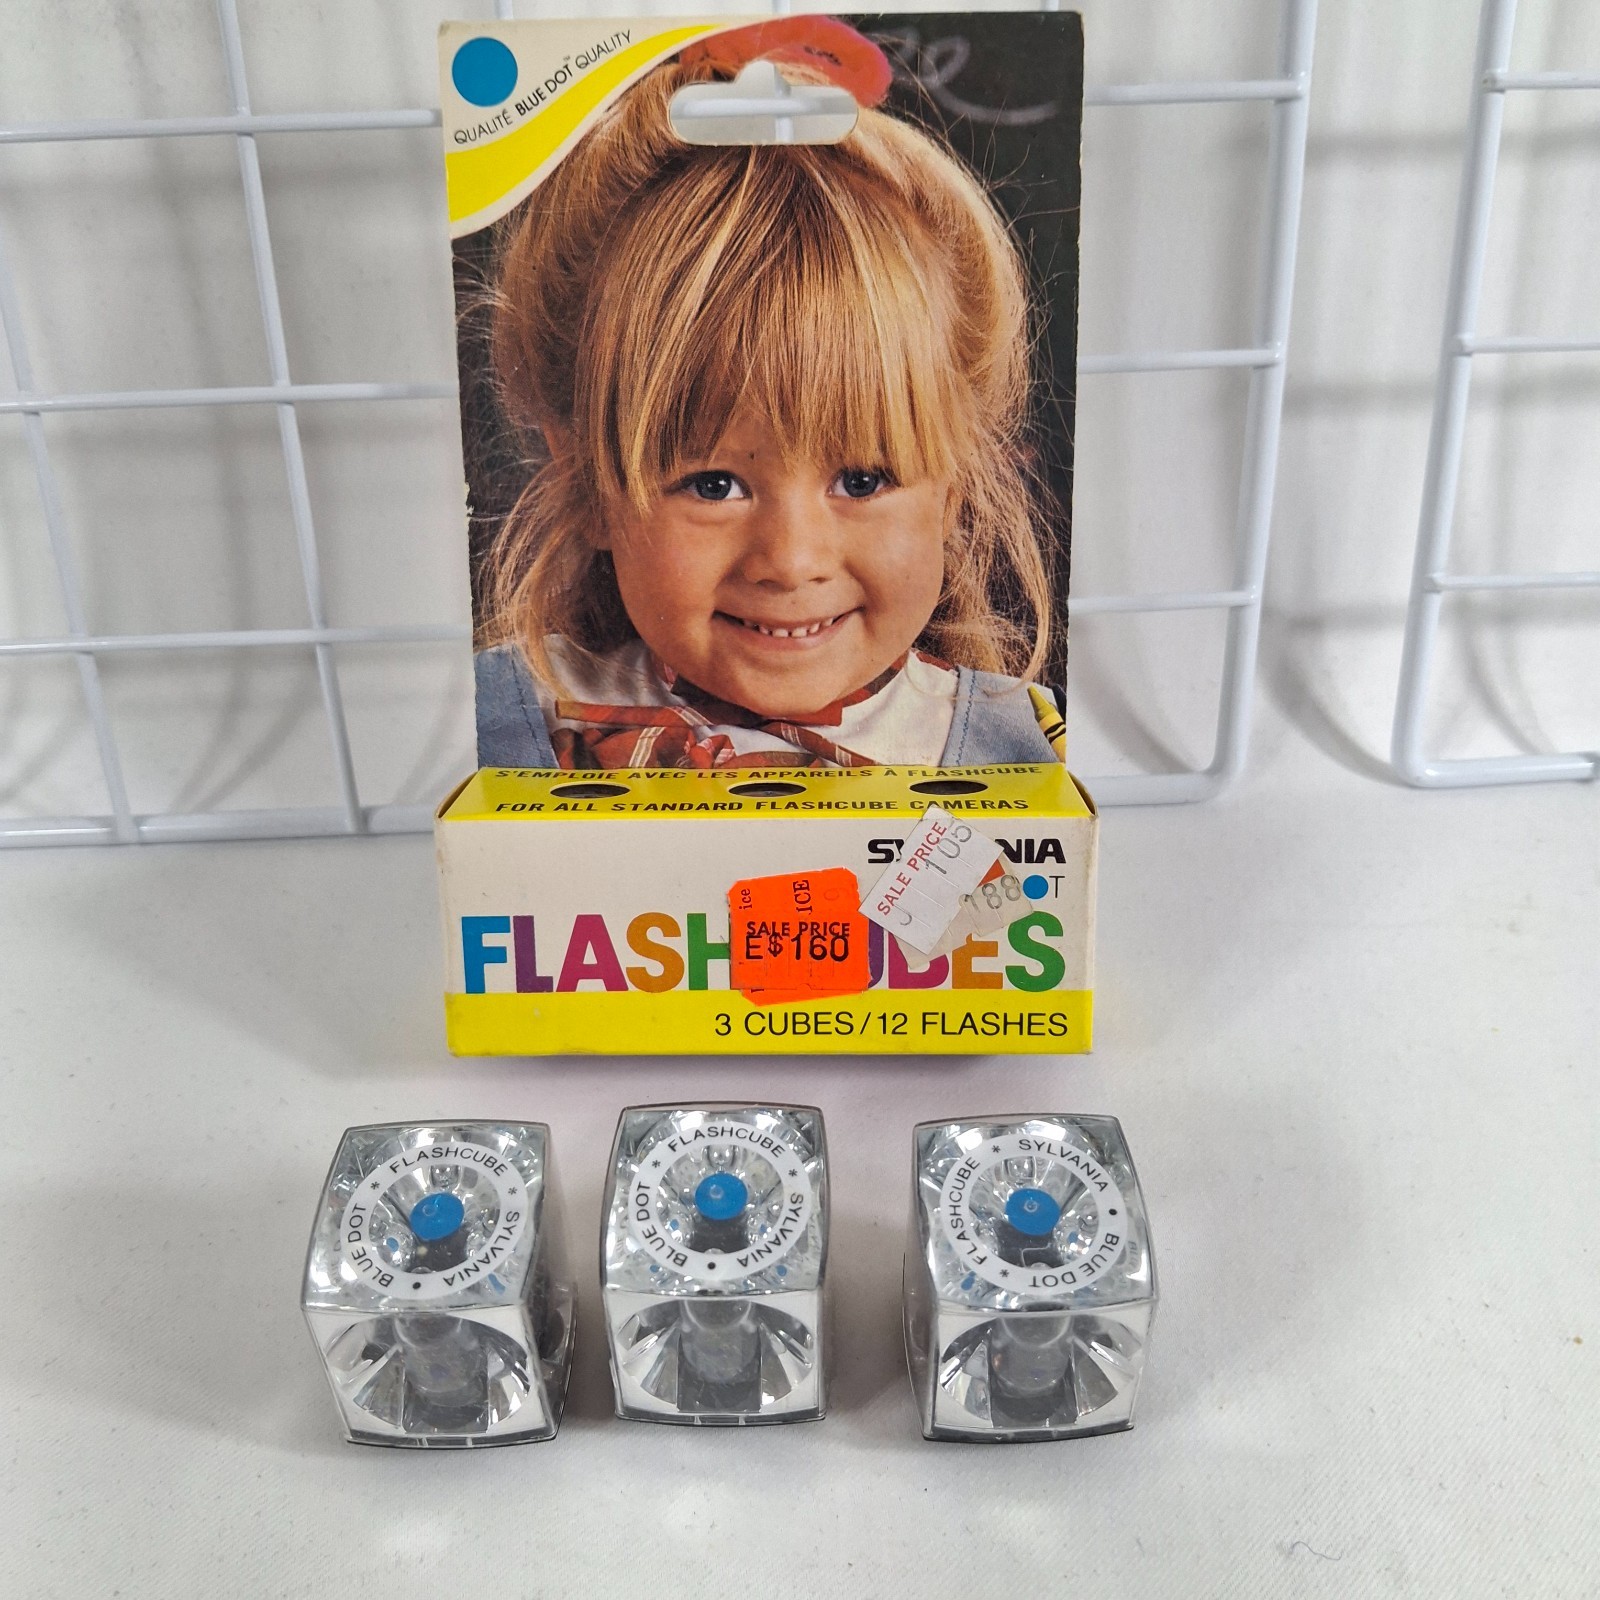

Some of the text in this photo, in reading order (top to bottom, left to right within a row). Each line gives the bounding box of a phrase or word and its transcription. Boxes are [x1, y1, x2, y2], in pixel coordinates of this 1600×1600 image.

[453, 109, 513, 144] QUALITÉ
[515, 87, 547, 117] BLUE
[575, 29, 632, 70] QUALITY
[496, 766, 1042, 780] S'EMPLOIE AVEC LES APPAREILS À FLASHCUBE
[496, 803, 545, 812] FOR
[553, 803, 598, 811] ALL
[611, 801, 743, 811] STANDARD
[756, 801, 898, 810] FLASHCUBE
[877, 822, 948, 916] SALE PRICE
[747, 921, 850, 936] SALE PRICE
[714, 1013, 732, 1036] 3
[921, 1012, 1068, 1036] FLASHES
[390, 1146, 508, 1177] FLASHCUBE
[668, 1126, 786, 1157] FLASHCUBE
[1019, 1139, 1109, 1192] SYLVANIA
[636, 1182, 688, 1267] BLUE DOT
[737, 1193, 803, 1267] SYLVANIA
[949, 1157, 987, 1265] FLASHCUBE
[348, 1203, 394, 1288] BLUE DOT
[443, 1211, 520, 1287] SYLVANIA
[1079, 1233, 1119, 1276] BLUE
[1029, 1270, 1077, 1288] DOT
